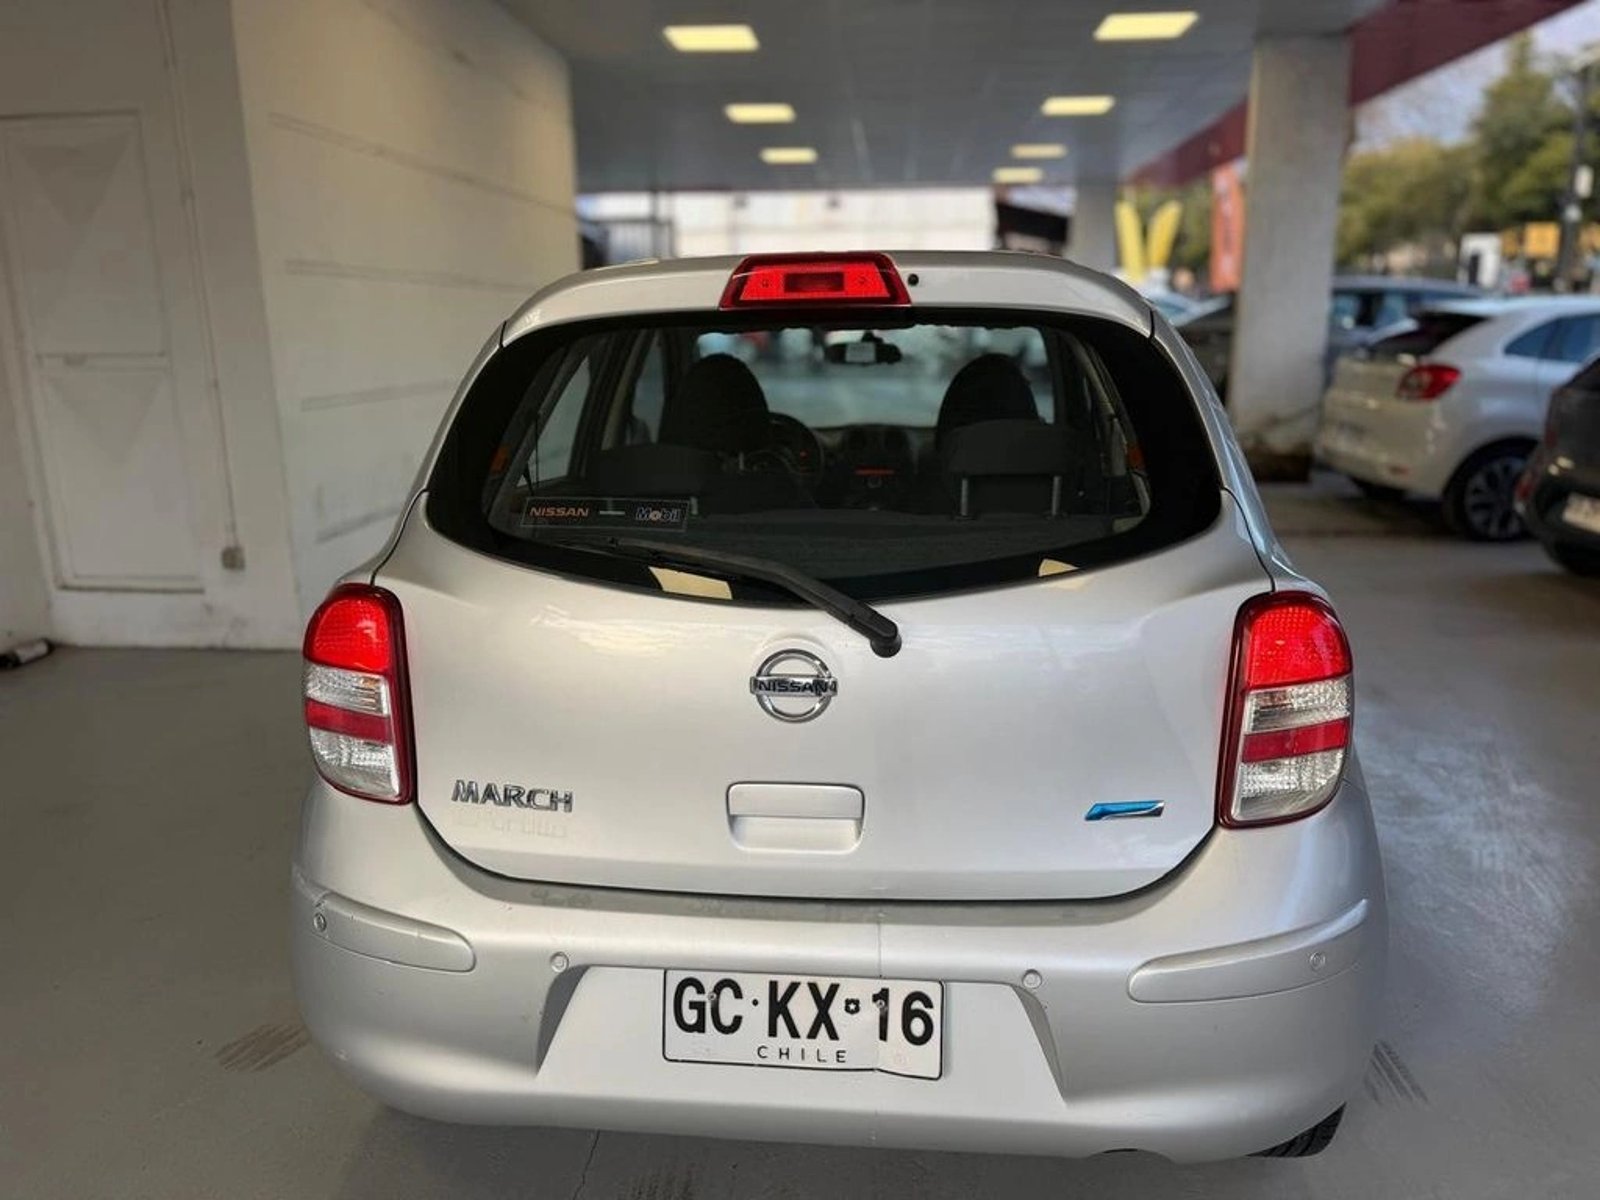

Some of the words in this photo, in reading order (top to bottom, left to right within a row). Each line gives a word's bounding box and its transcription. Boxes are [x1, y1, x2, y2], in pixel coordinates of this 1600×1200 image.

[528, 506, 590, 519] NISSAN
[757, 679, 830, 694] NISSAN
[451, 779, 573, 813] MARCH
[757, 1046, 848, 1063] CHILE
